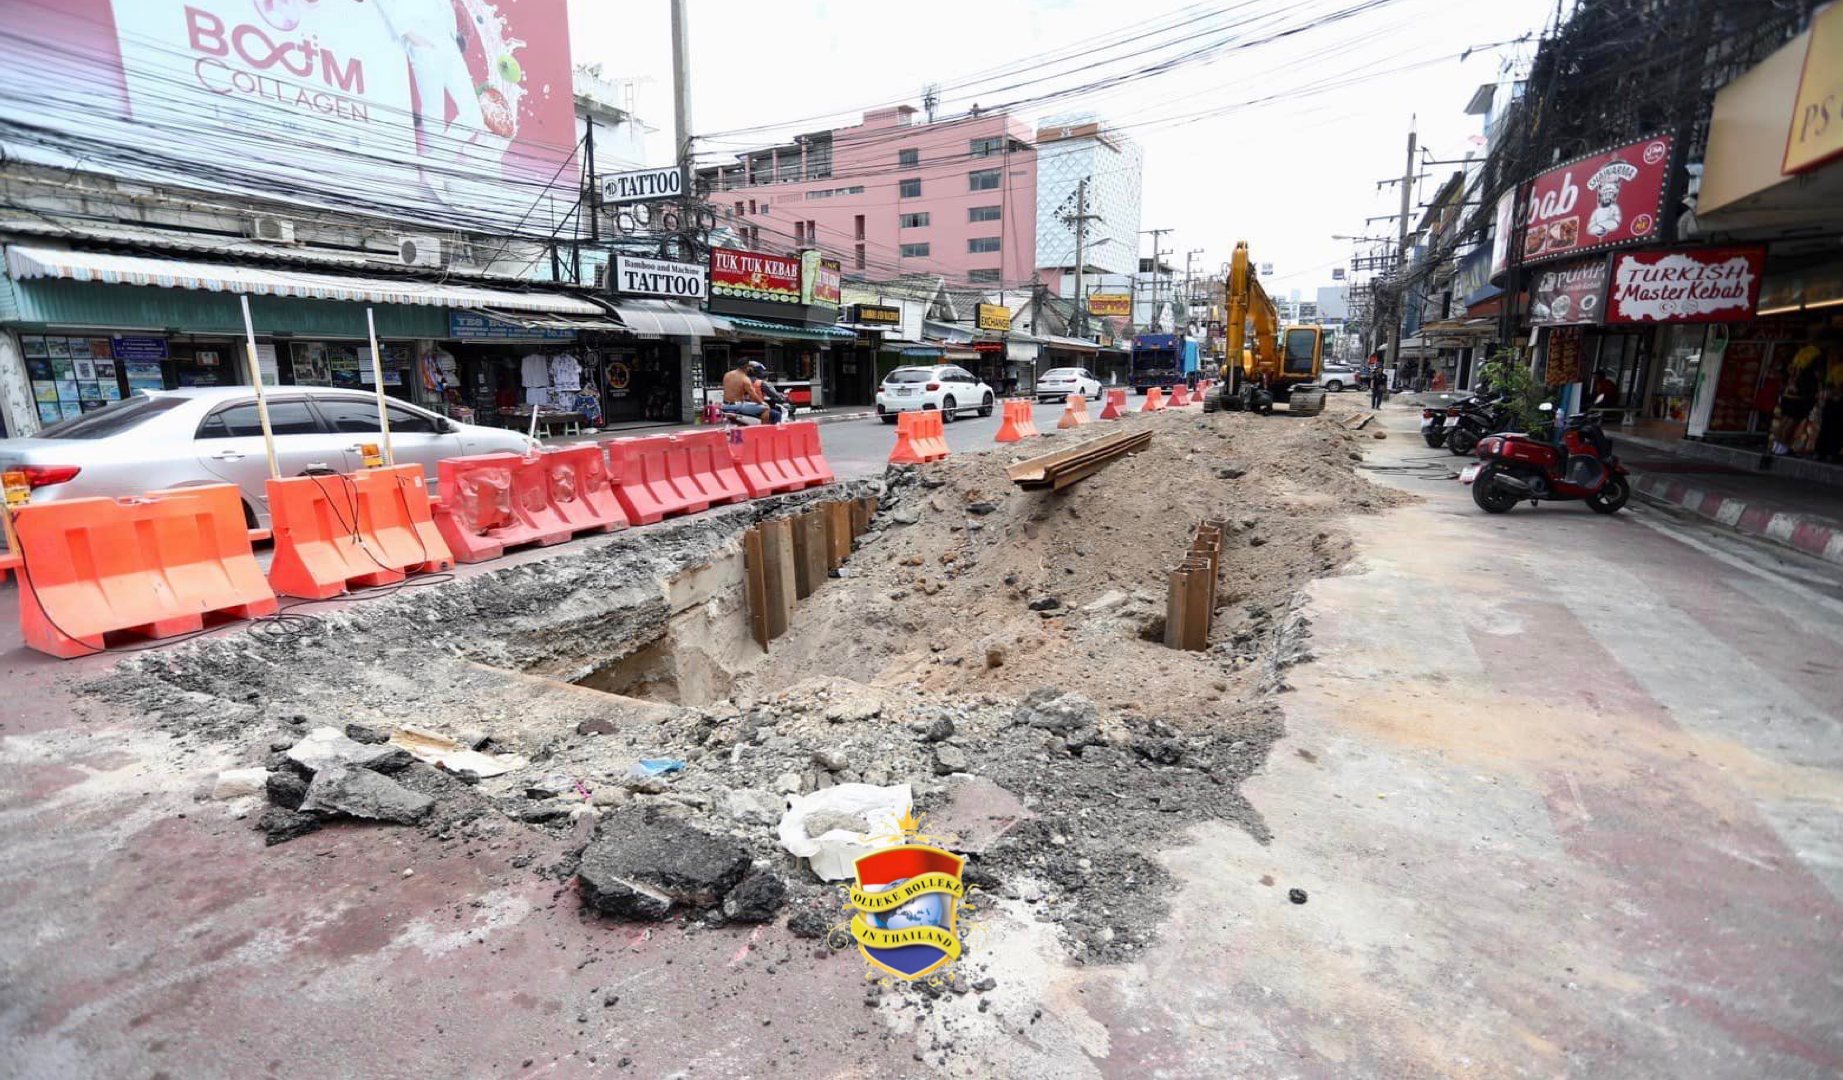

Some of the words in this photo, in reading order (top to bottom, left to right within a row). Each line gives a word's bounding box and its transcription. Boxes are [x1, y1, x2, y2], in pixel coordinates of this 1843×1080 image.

[618, 171, 680, 197] TATTOO
[625, 259, 656, 270] Bamboo
[657, 264, 671, 272] and
[716, 253, 738, 270] TUK
[740, 256, 762, 273] TUK
[764, 260, 798, 277] KEBAB
[1629, 265, 1745, 283] TURKISH
[624, 271, 700, 296] TATTOO
[981, 315, 1010, 329] EXCHANGE
